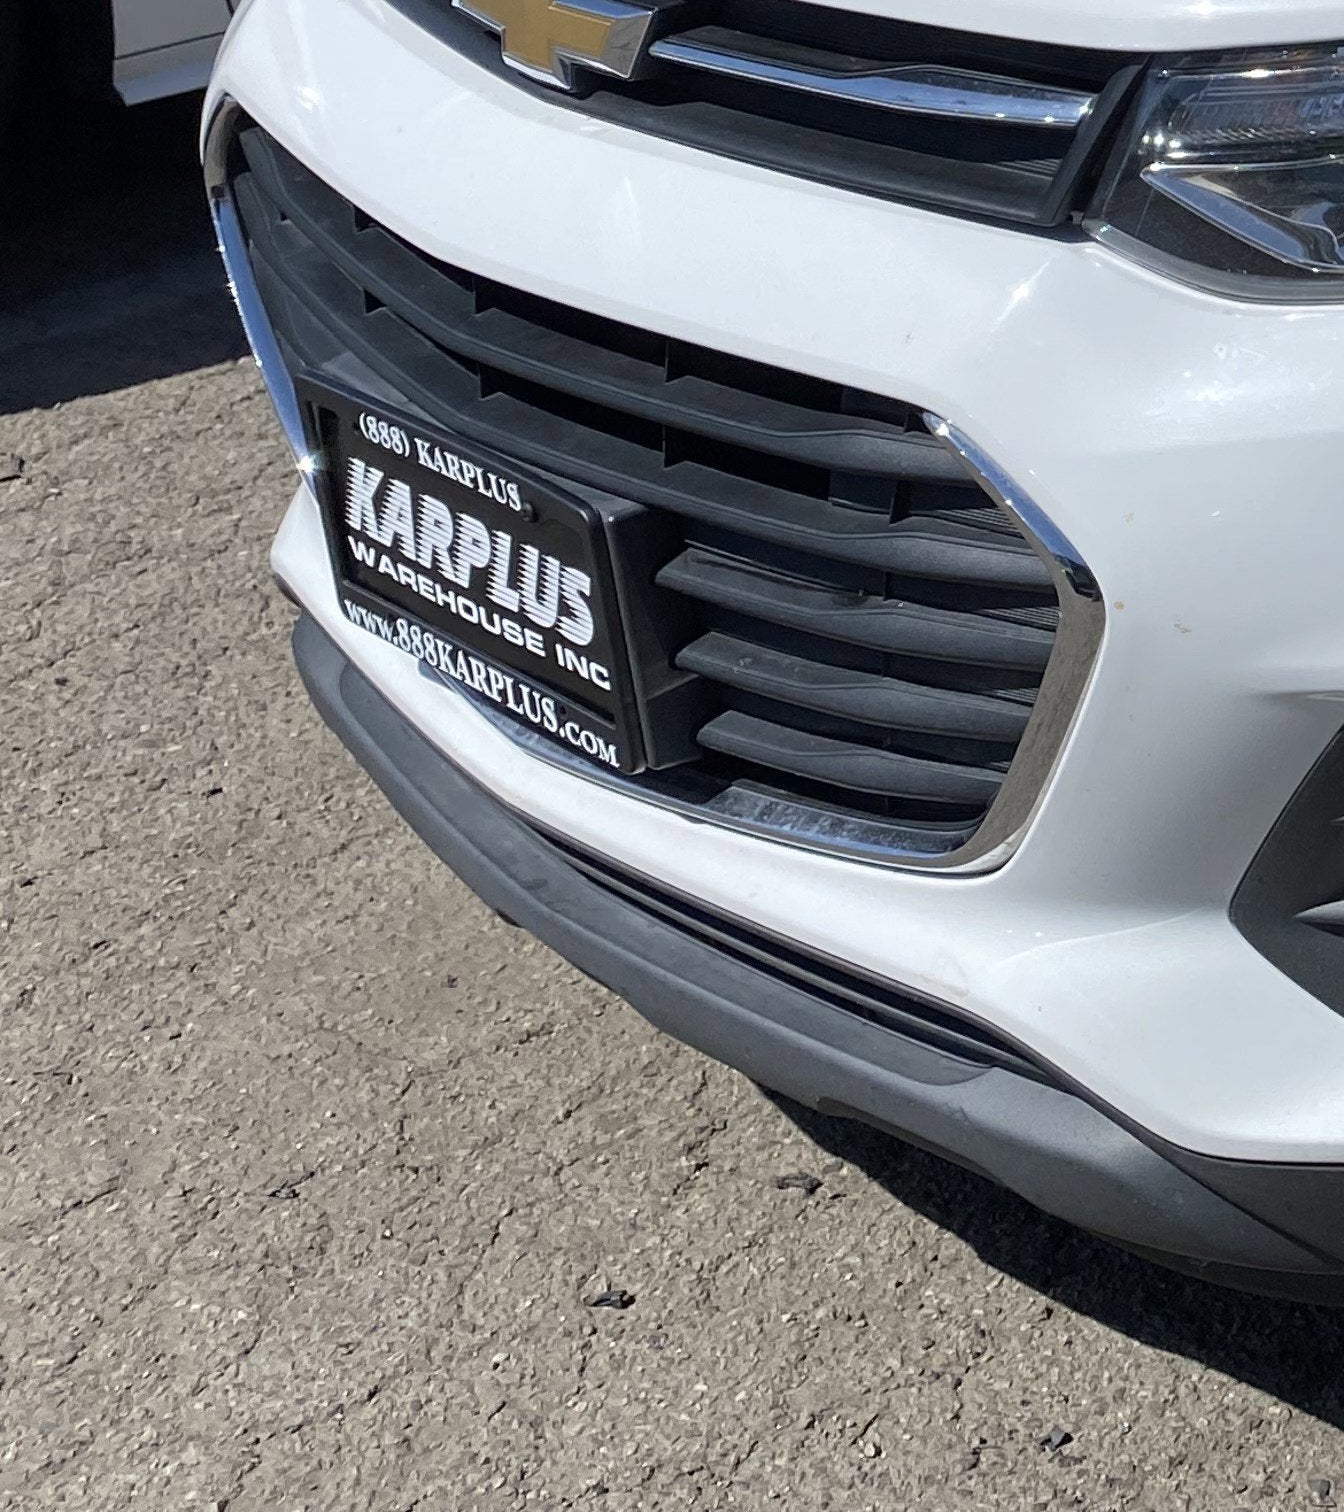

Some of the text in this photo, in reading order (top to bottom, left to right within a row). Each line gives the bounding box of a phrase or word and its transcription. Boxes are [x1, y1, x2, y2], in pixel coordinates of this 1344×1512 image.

[358, 411, 522, 513] (888) KARPLUS
[345, 456, 596, 647] KARPLUS
[347, 535, 612, 692] WAREHOUSE INC
